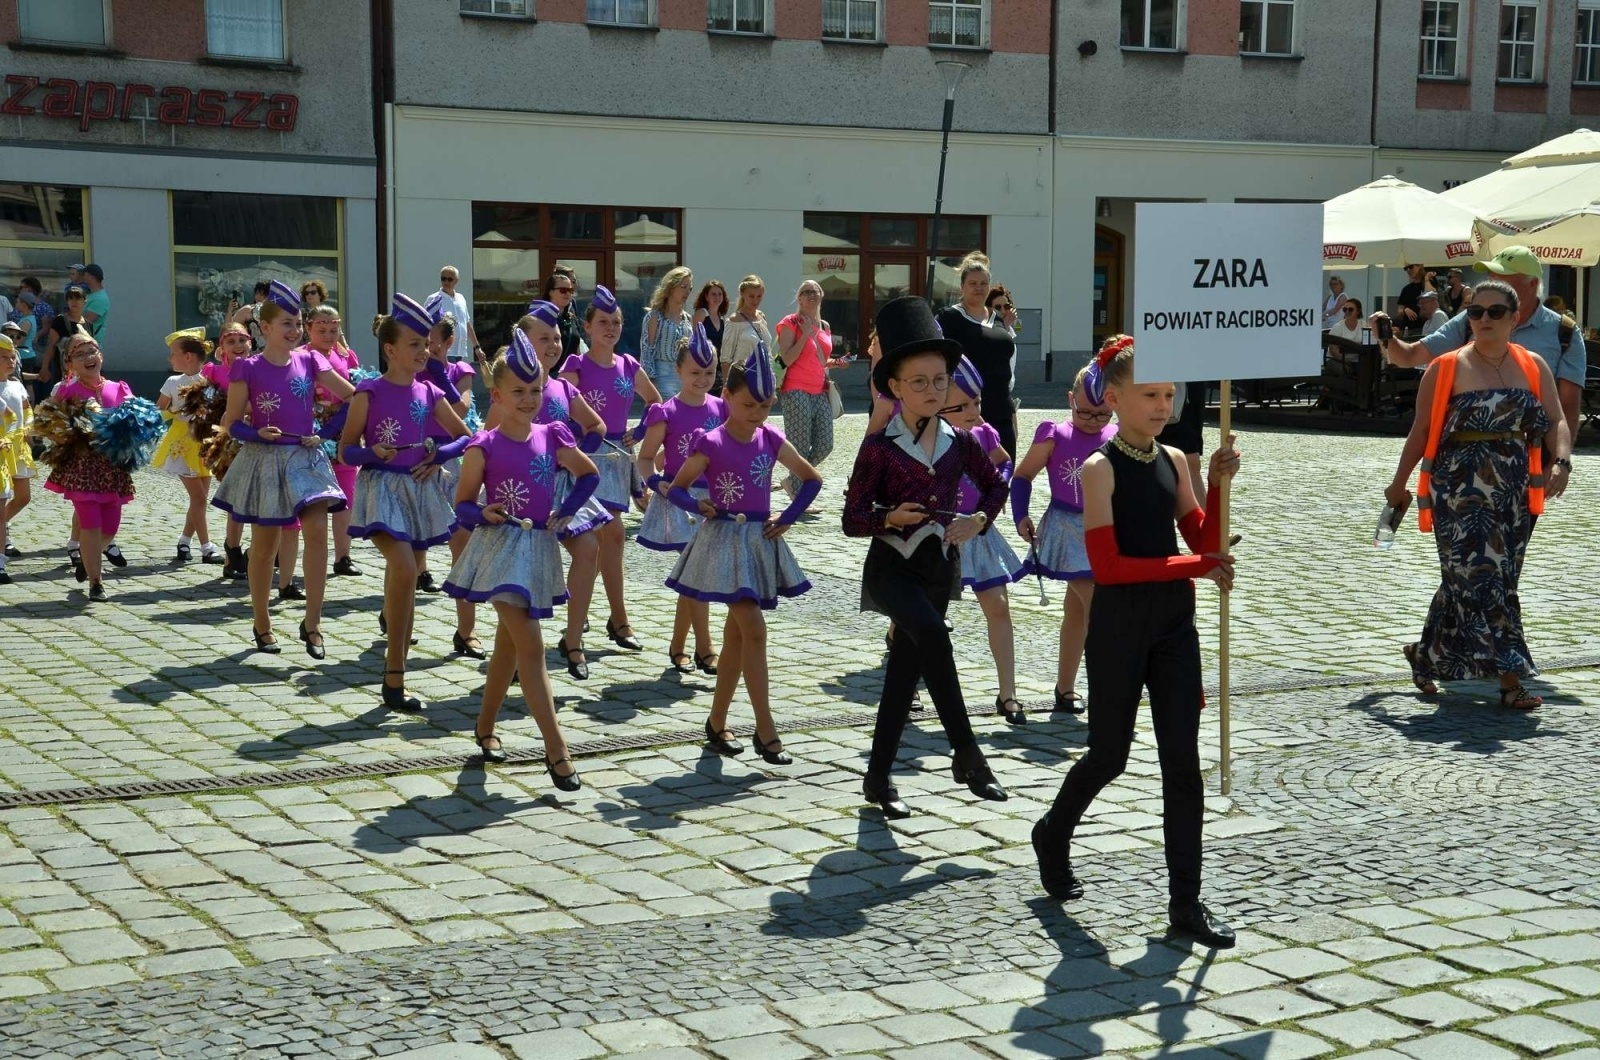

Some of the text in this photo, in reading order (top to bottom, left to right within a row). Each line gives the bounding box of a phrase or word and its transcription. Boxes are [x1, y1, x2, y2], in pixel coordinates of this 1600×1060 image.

[2, 74, 299, 132] zaprasza
[1322, 245, 1354, 256] YWIEC
[1192, 258, 1269, 288] ZARA
[1143, 308, 1314, 331] POWIAT RACIBORSKI
